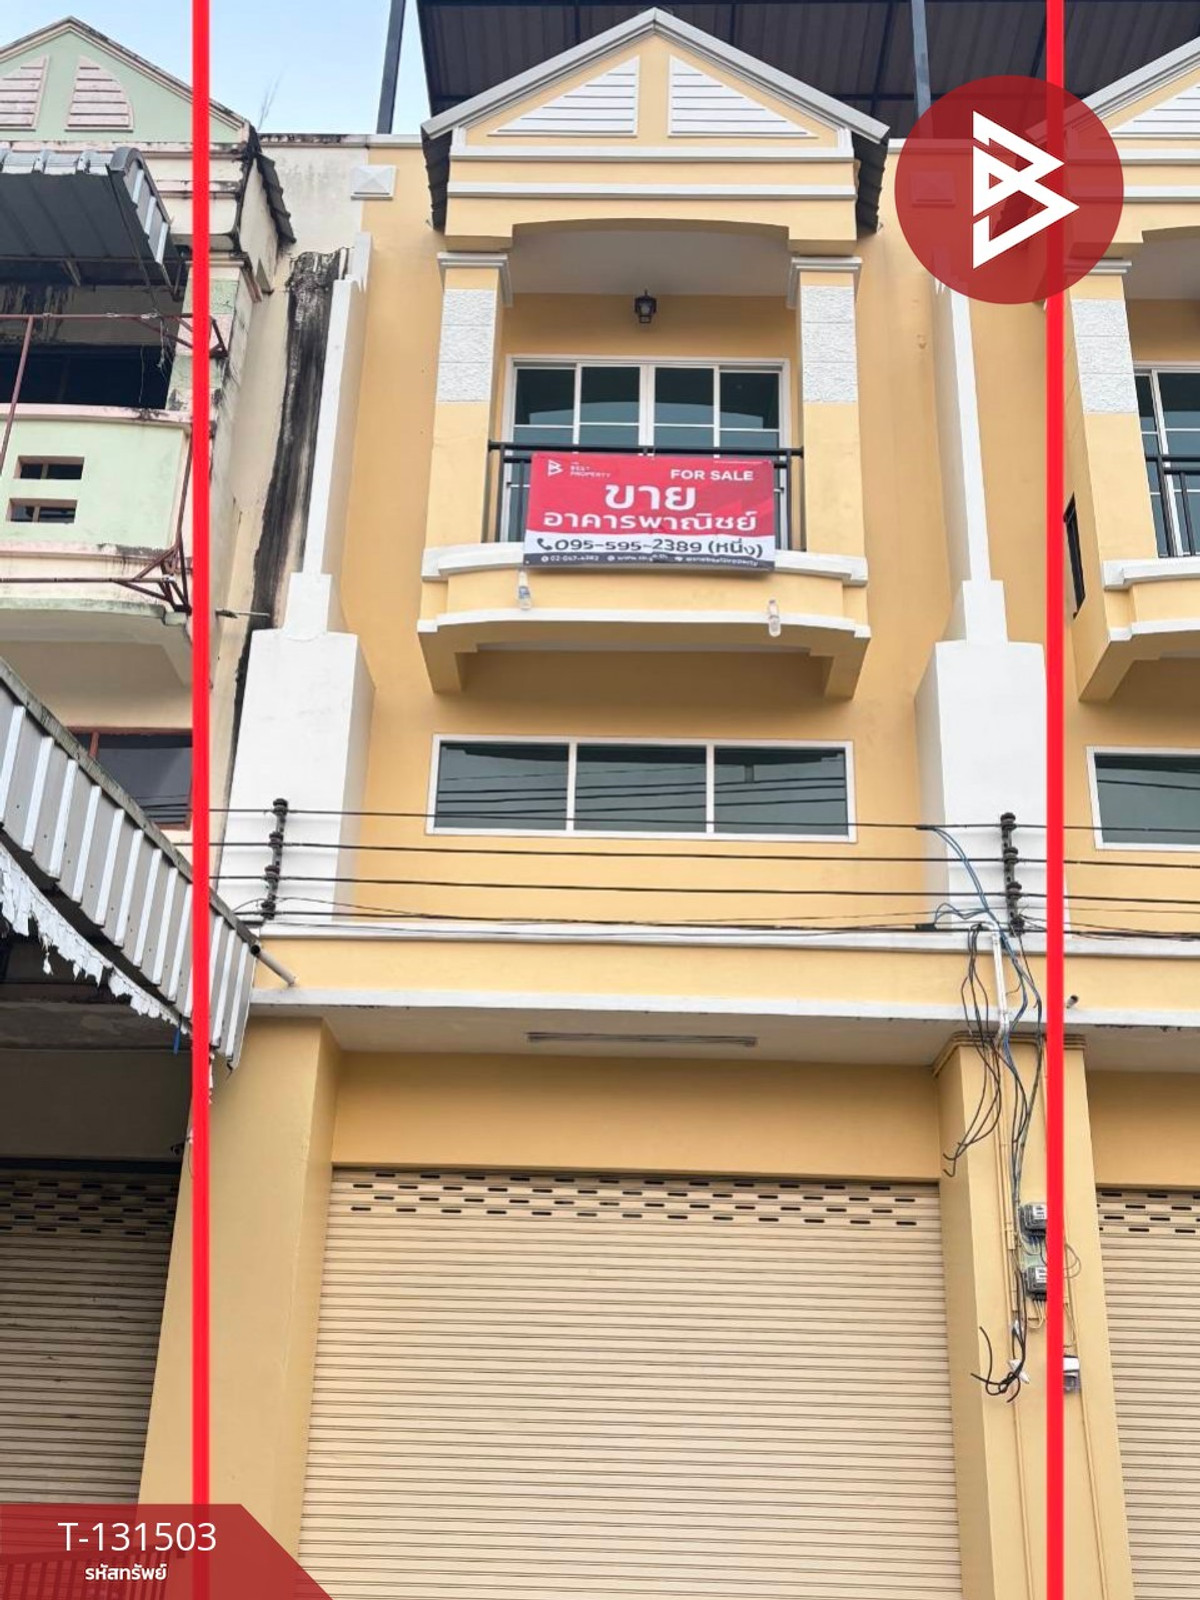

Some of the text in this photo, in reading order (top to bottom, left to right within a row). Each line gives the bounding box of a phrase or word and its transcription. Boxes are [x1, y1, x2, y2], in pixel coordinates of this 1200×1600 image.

[670, 469, 754, 481] FOR SALE
[605, 484, 696, 511] ขาย
[543, 511, 758, 531] อาคารพาณิชย์
[554, 538, 702, 553] 095-595-2389
